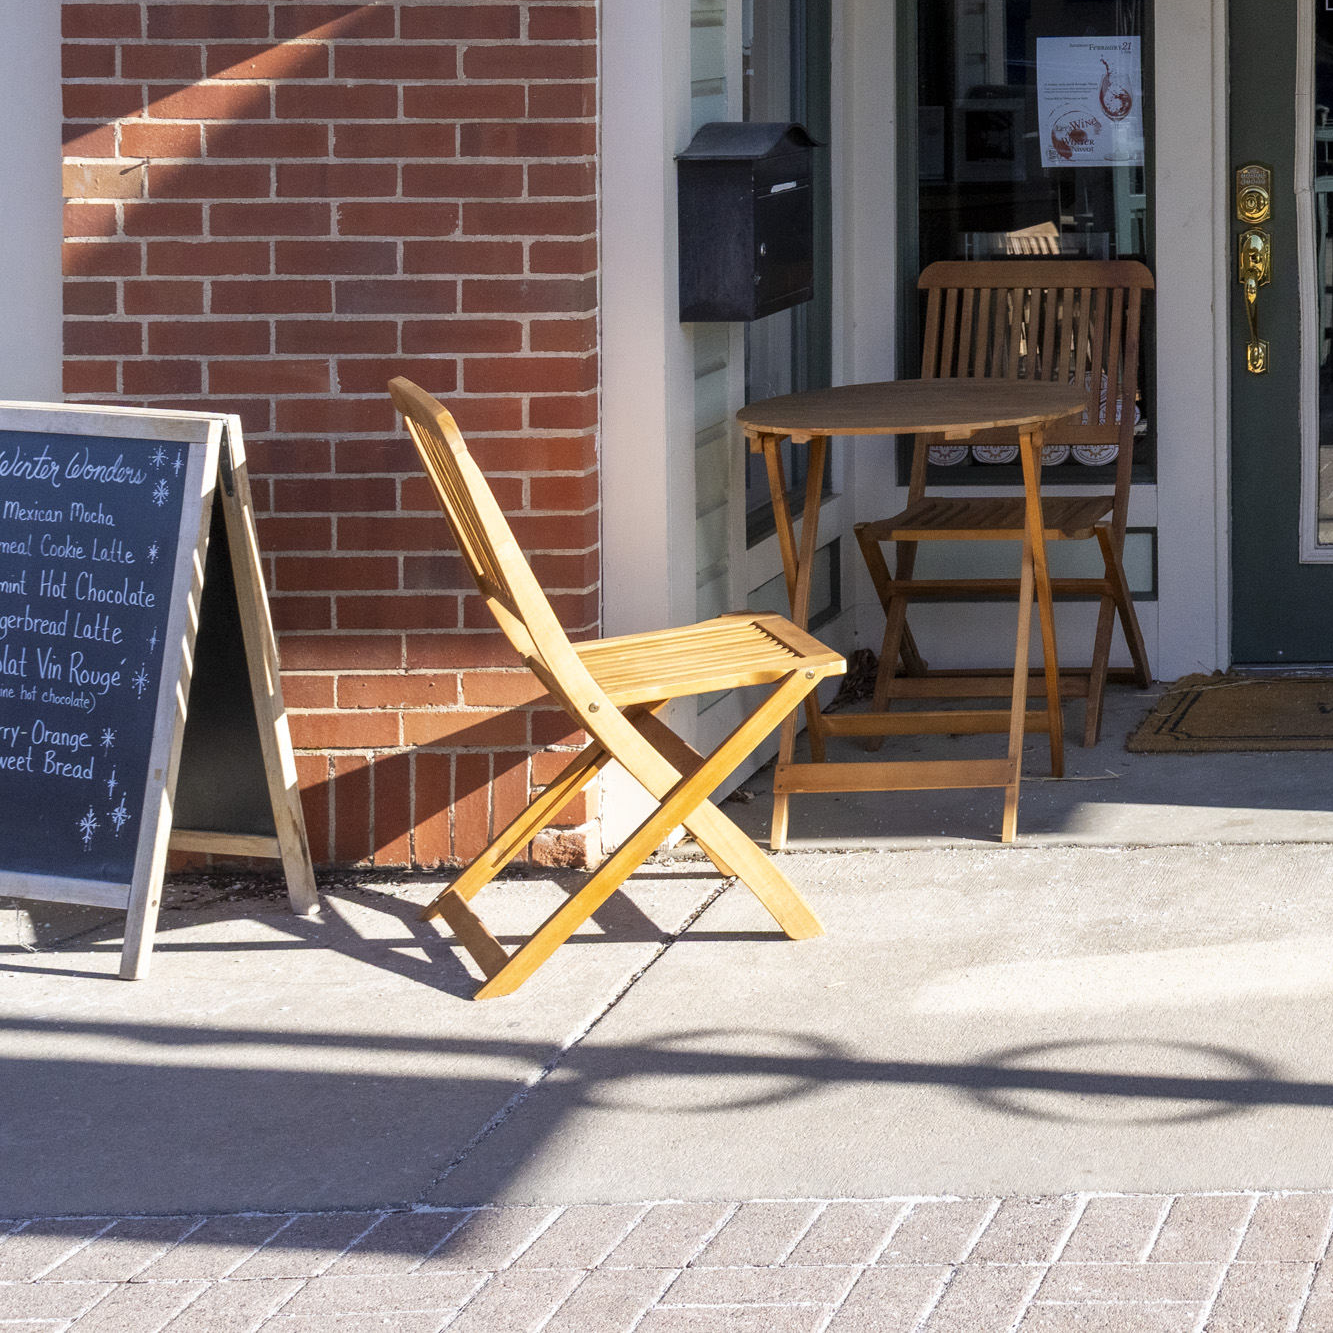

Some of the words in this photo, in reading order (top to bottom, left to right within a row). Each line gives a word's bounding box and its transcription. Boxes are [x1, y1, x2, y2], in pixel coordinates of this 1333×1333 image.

[1122, 42, 1131, 50] 21
[65, 447, 147, 485] Wonders
[3, 500, 63, 523] Mexican
[70, 502, 115, 526] Mocha
[41, 534, 86, 560] Cookie
[92, 538, 135, 564] Latte
[40, 570, 67, 599] Hot
[76, 572, 155, 608] Chocolate
[74, 612, 123, 644] Latte
[37, 647, 62, 680] Vin
[20, 684, 38, 701] hot
[43, 750, 94, 780] Bread
